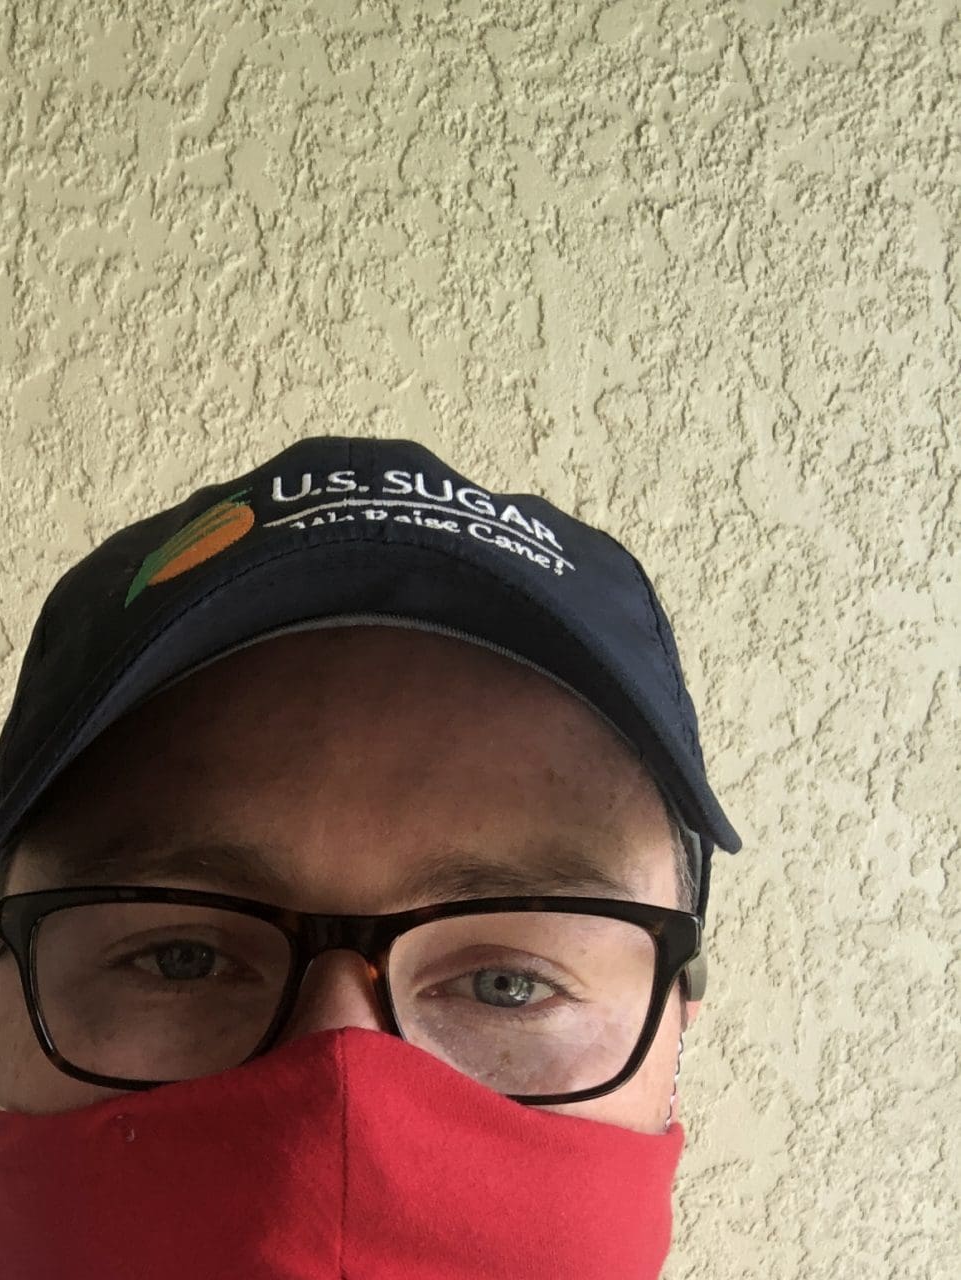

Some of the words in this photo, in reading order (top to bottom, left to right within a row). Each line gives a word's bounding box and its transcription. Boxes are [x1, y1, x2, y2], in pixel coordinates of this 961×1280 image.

[272, 470, 369, 502] U.S.
[382, 470, 564, 551] SUGAR
[467, 521, 566, 576] Cane!
